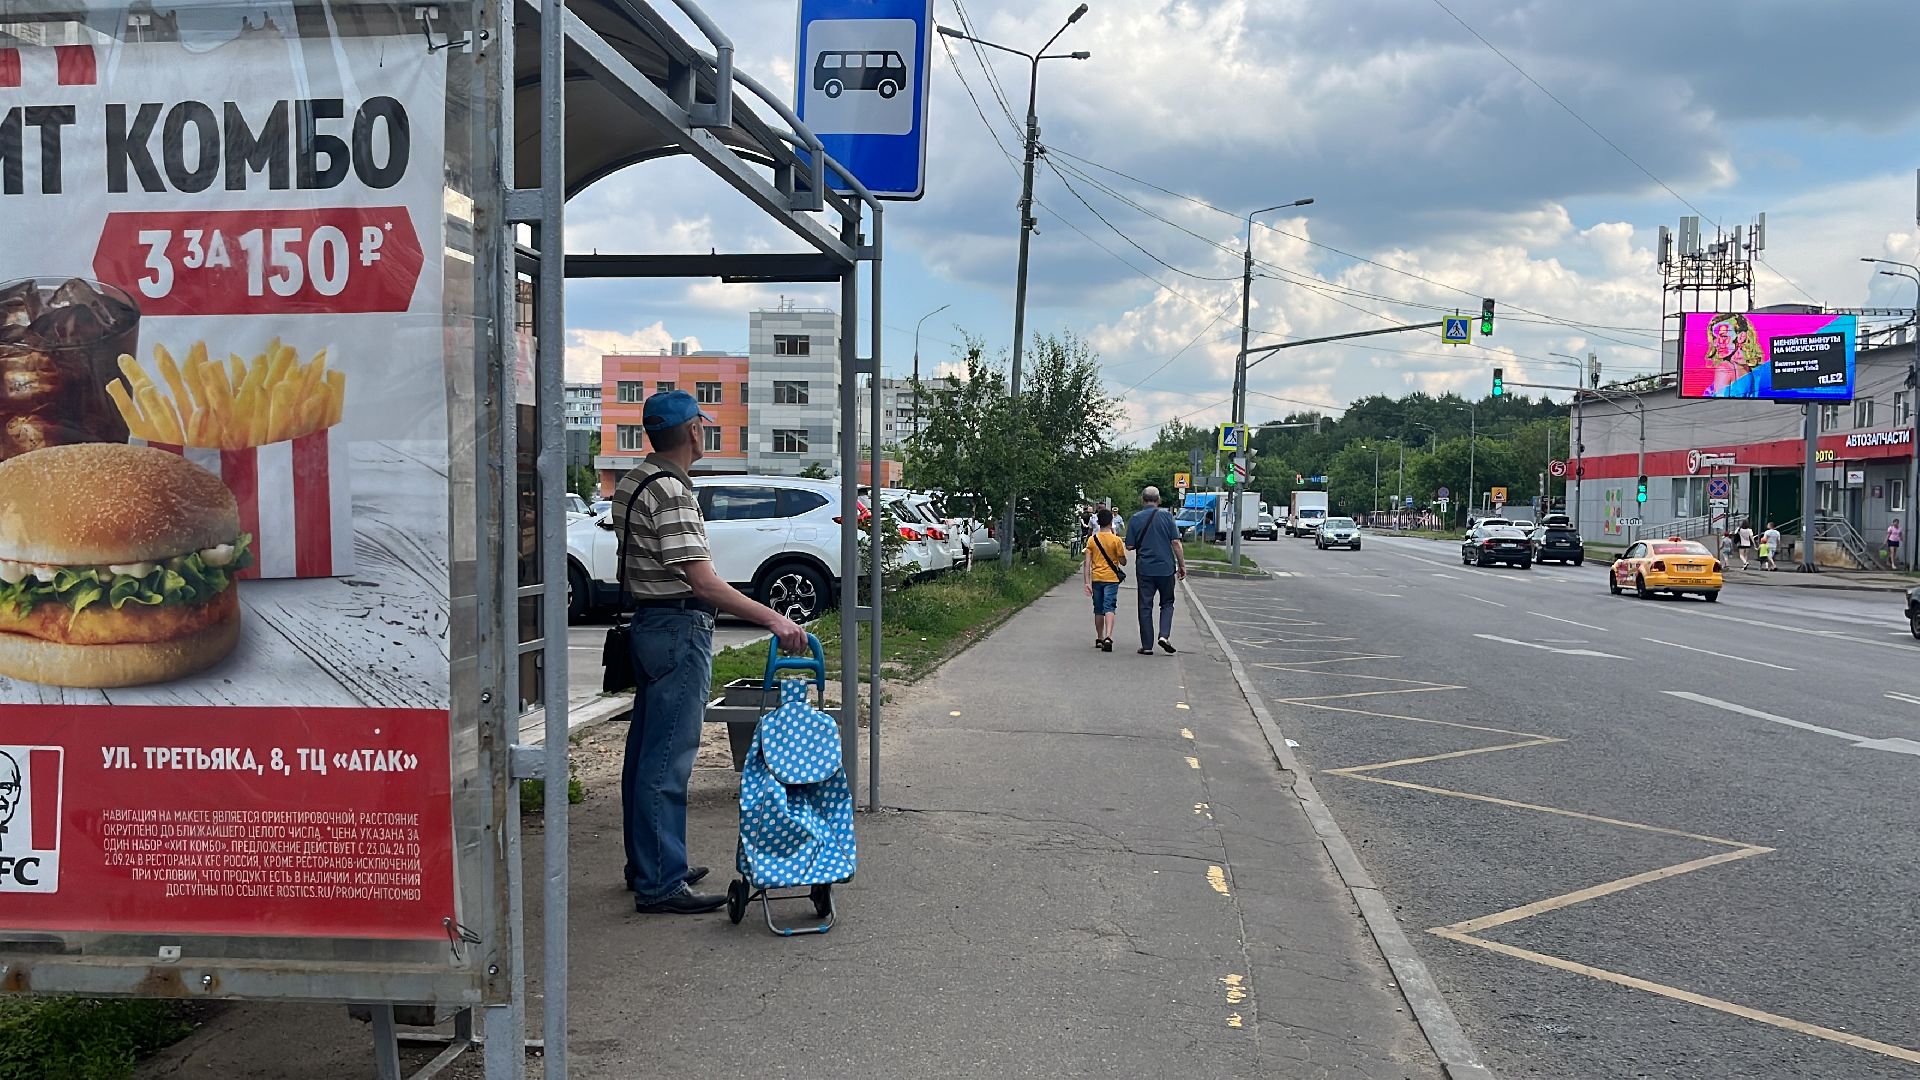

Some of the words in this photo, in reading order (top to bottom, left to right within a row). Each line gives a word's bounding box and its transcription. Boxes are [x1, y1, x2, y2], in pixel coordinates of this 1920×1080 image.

[105, 96, 410, 193] КОМБО
[138, 229, 174, 299] 3
[183, 229, 231, 269] ЗА
[240, 225, 349, 297] 150
[1773, 337, 1808, 347] МЕНЯЙТЕ
[1809, 335, 1841, 345] МИНУТЫ
[1773, 346, 1784, 354] НА
[1785, 343, 1830, 353] ИСКУССТВО
[1818, 372, 1843, 384] TELE2
[1845, 430, 1910, 447] АВТОЗАПЧАСТИ
[102, 746, 137, 770] УЛ.
[143, 747, 264, 776] ТРЕТЬЯКА,
[270, 748, 290, 776] 8,
[297, 748, 327, 776] ТЦ
[333, 749, 418, 772] «АТАК»
[103, 809, 156, 823] НАВИГАЦИЯ
[159, 810, 171, 822] НА
[175, 810, 209, 822] МАКЕТЕ
[213, 810, 259, 823] ЯВЛЯЕТСЯ
[262, 809, 357, 826] ОРИЕНТИРОВОЧНОЙ,
[360, 812, 419, 826] РАССТОЯНИЕ
[103, 823, 158, 836] ОКРУГЛЕНО
[160, 825, 174, 838] ДО
[177, 822, 246, 838] БЛИЖАЙШЕГО
[248, 825, 286, 839] ЦЕЛОГО
[360, 828, 404, 841] УКАЗАНА
[407, 828, 419, 841] ЗА
[103, 839, 130, 852] ОДИН
[132, 839, 162, 851] НАБОР
[164, 840, 187, 852] «ХИТ
[190, 840, 229, 853] КОМБО».
[231, 840, 301, 854] ПРЕДЛОЖЕНИЕ
[303, 838, 356, 855] ДЕЙСТВУЕТ
[358, 842, 365, 855] С
[367, 843, 405, 856] 23.04.24
[407, 843, 420, 856] ПО
[104, 853, 135, 866] 2.09.24
[138, 854, 144, 866] В
[146, 854, 202, 867] РЕСТОРАНАХ
[205, 854, 221, 867] KFC
[223, 855, 261, 869] РОССИЯ,
[264, 855, 294, 868] КРОМЕ
[132, 868, 151, 881] ПРИ
[153, 869, 200, 883] УСЛОВИИ,
[202, 869, 221, 882] ЧТО
[223, 870, 267, 884] ПРОДУКТ
[269, 870, 293, 883] ЕСТЬ
[294, 871, 301, 883] В
[303, 871, 352, 884] НАЛИЧИИ.
[355, 872, 421, 885] ИСКЛЮЧЕНИЯ
[166, 884, 219, 897] ДОСТУПНЫ
[221, 884, 234, 897] ПО
[236, 885, 274, 898] ССЫЛКЕ
[276, 885, 421, 901] ROSTICS.RU/PROMO/HITCOMBO
